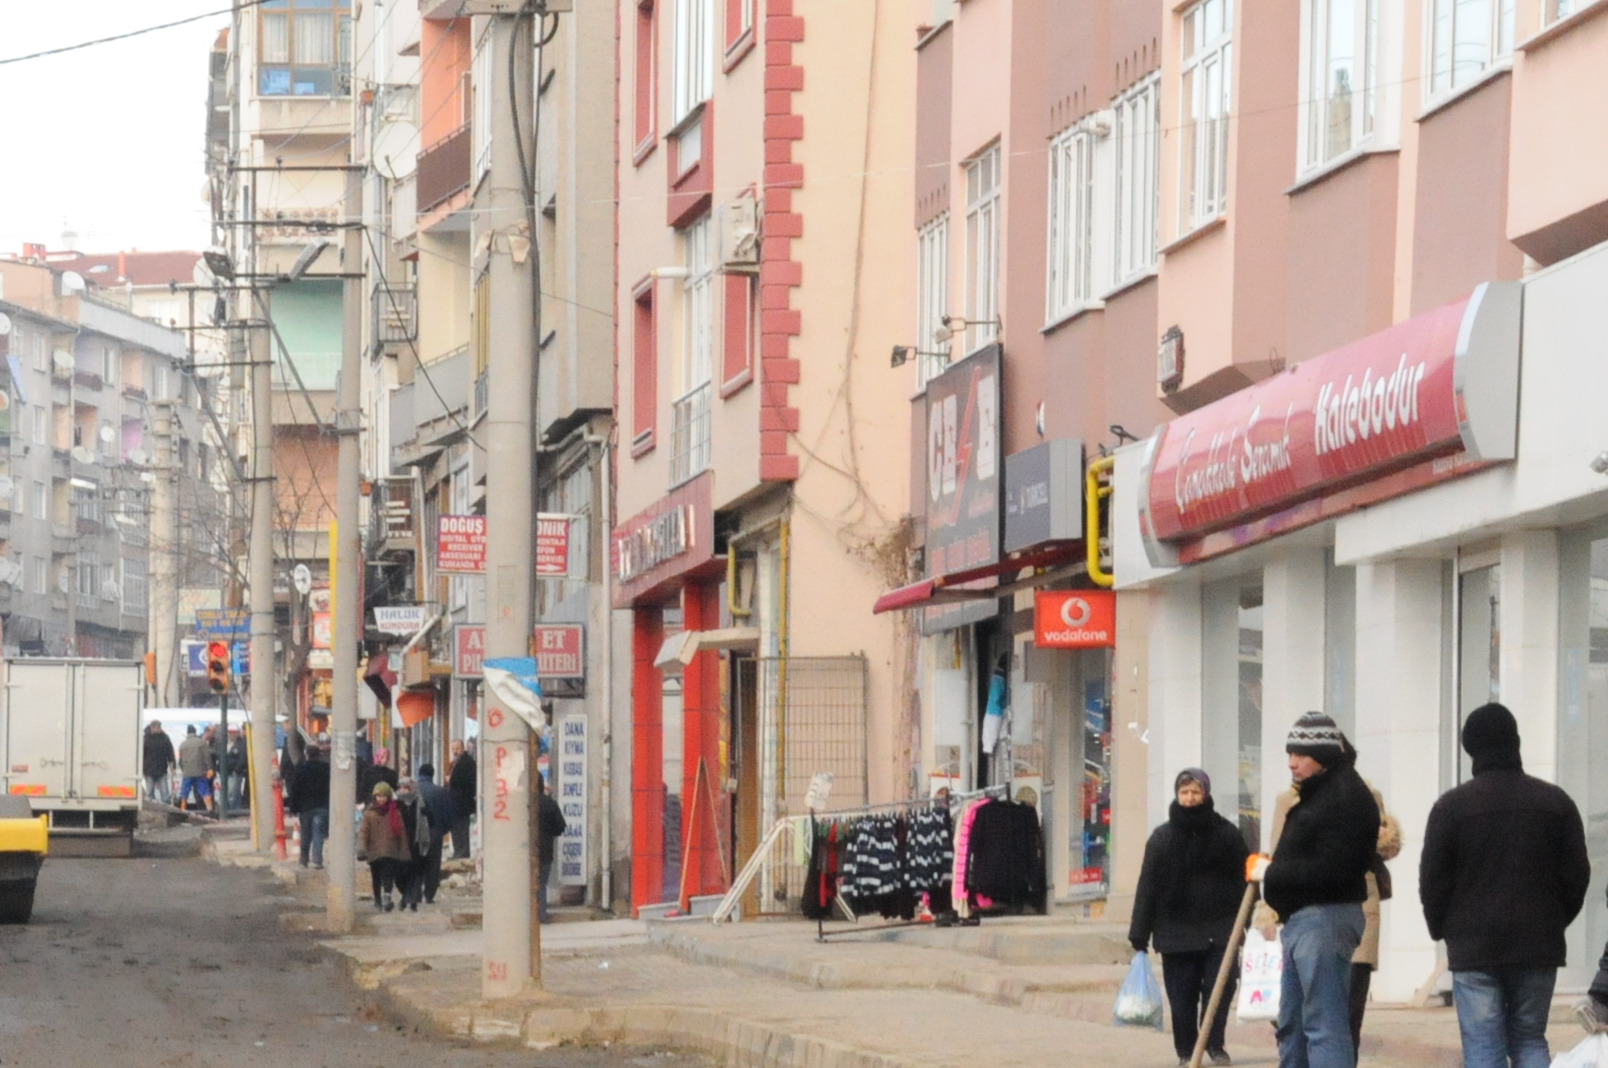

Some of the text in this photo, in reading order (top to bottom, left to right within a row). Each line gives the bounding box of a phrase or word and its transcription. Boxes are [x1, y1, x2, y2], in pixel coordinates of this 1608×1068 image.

[1315, 353, 1425, 456] Kalebodur
[440, 516, 566, 535] DOĞUŞ ONİK
[380, 609, 421, 620] HALUK
[542, 630, 566, 649] ET
[1044, 629, 1107, 642] vodafone
[537, 652, 576, 673] ÜTERİ
[565, 722, 584, 736] DANA
[563, 803, 583, 817] KUZU
